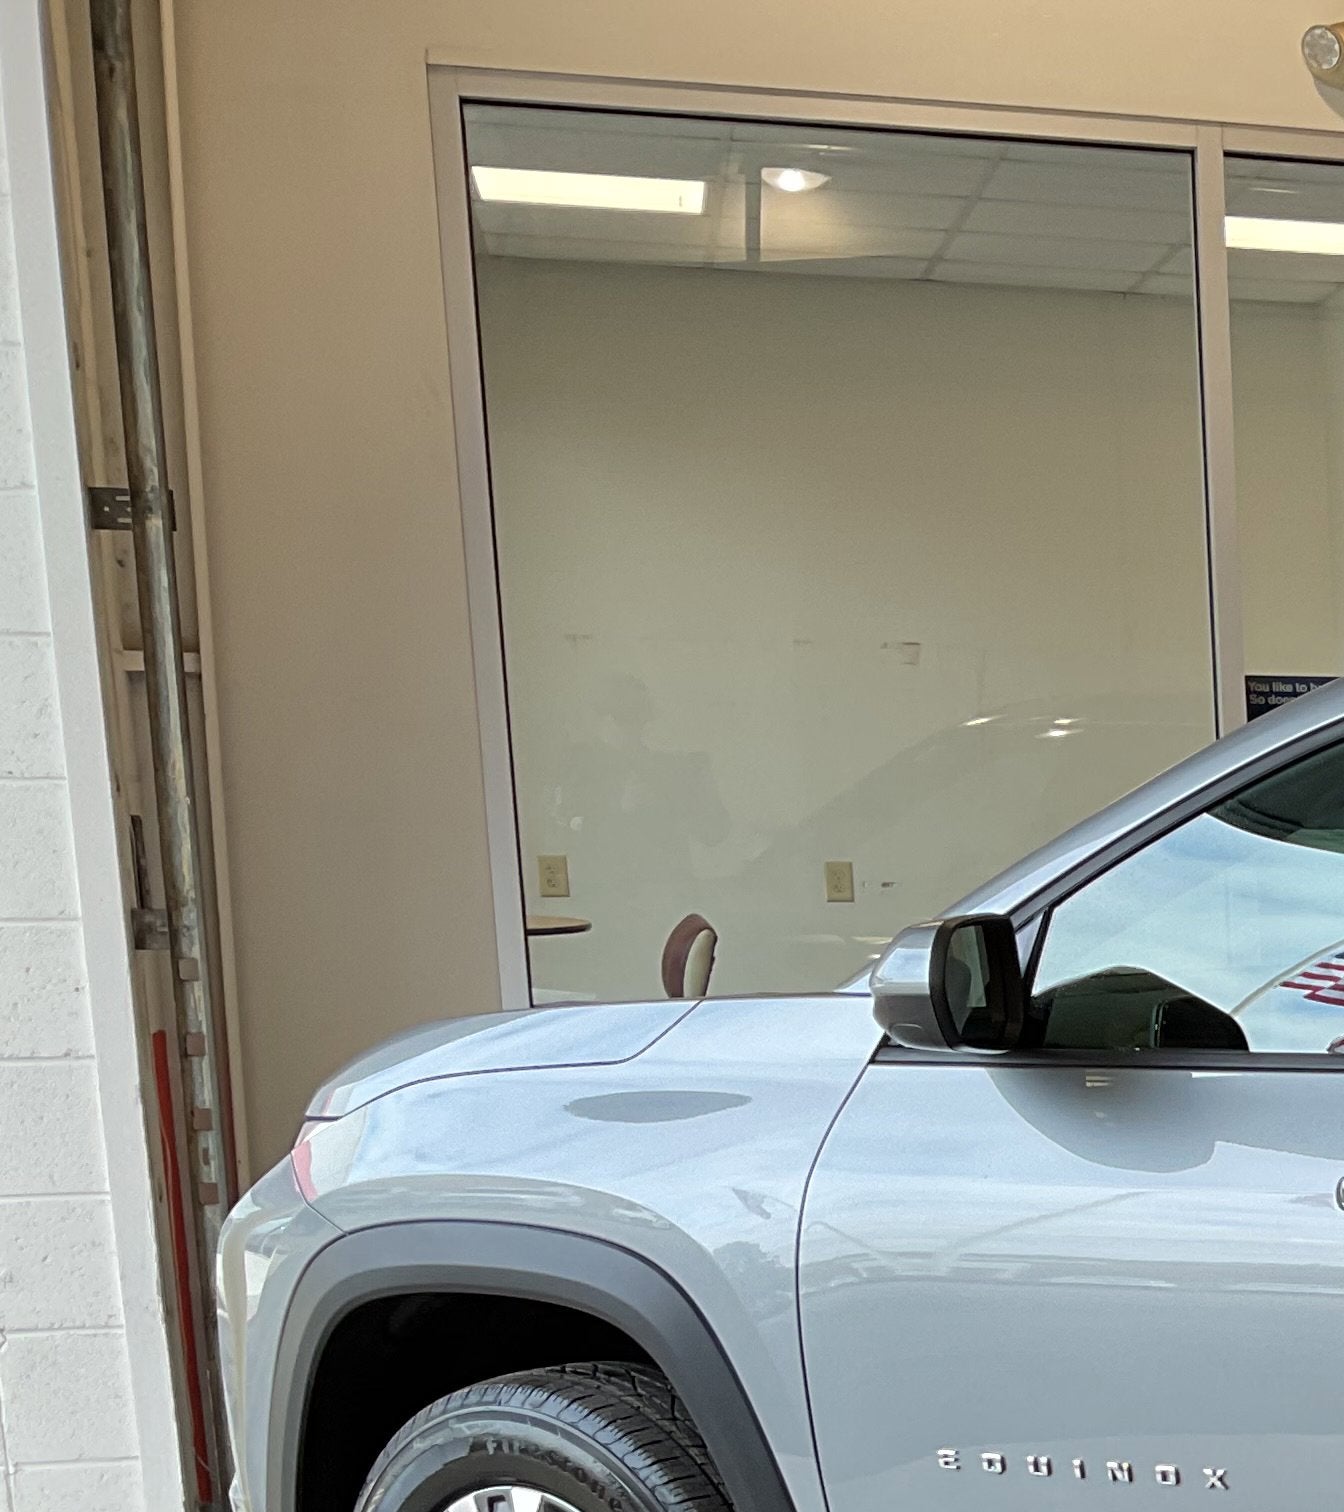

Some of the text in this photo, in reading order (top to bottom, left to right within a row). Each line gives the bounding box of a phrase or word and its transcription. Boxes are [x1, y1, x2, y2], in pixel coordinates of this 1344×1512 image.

[1247, 681, 1270, 692] You
[1272, 681, 1293, 692] like
[1295, 682, 1308, 693] to
[1249, 694, 1266, 705] So
[936, 1448, 1229, 1491] EQUINOX
